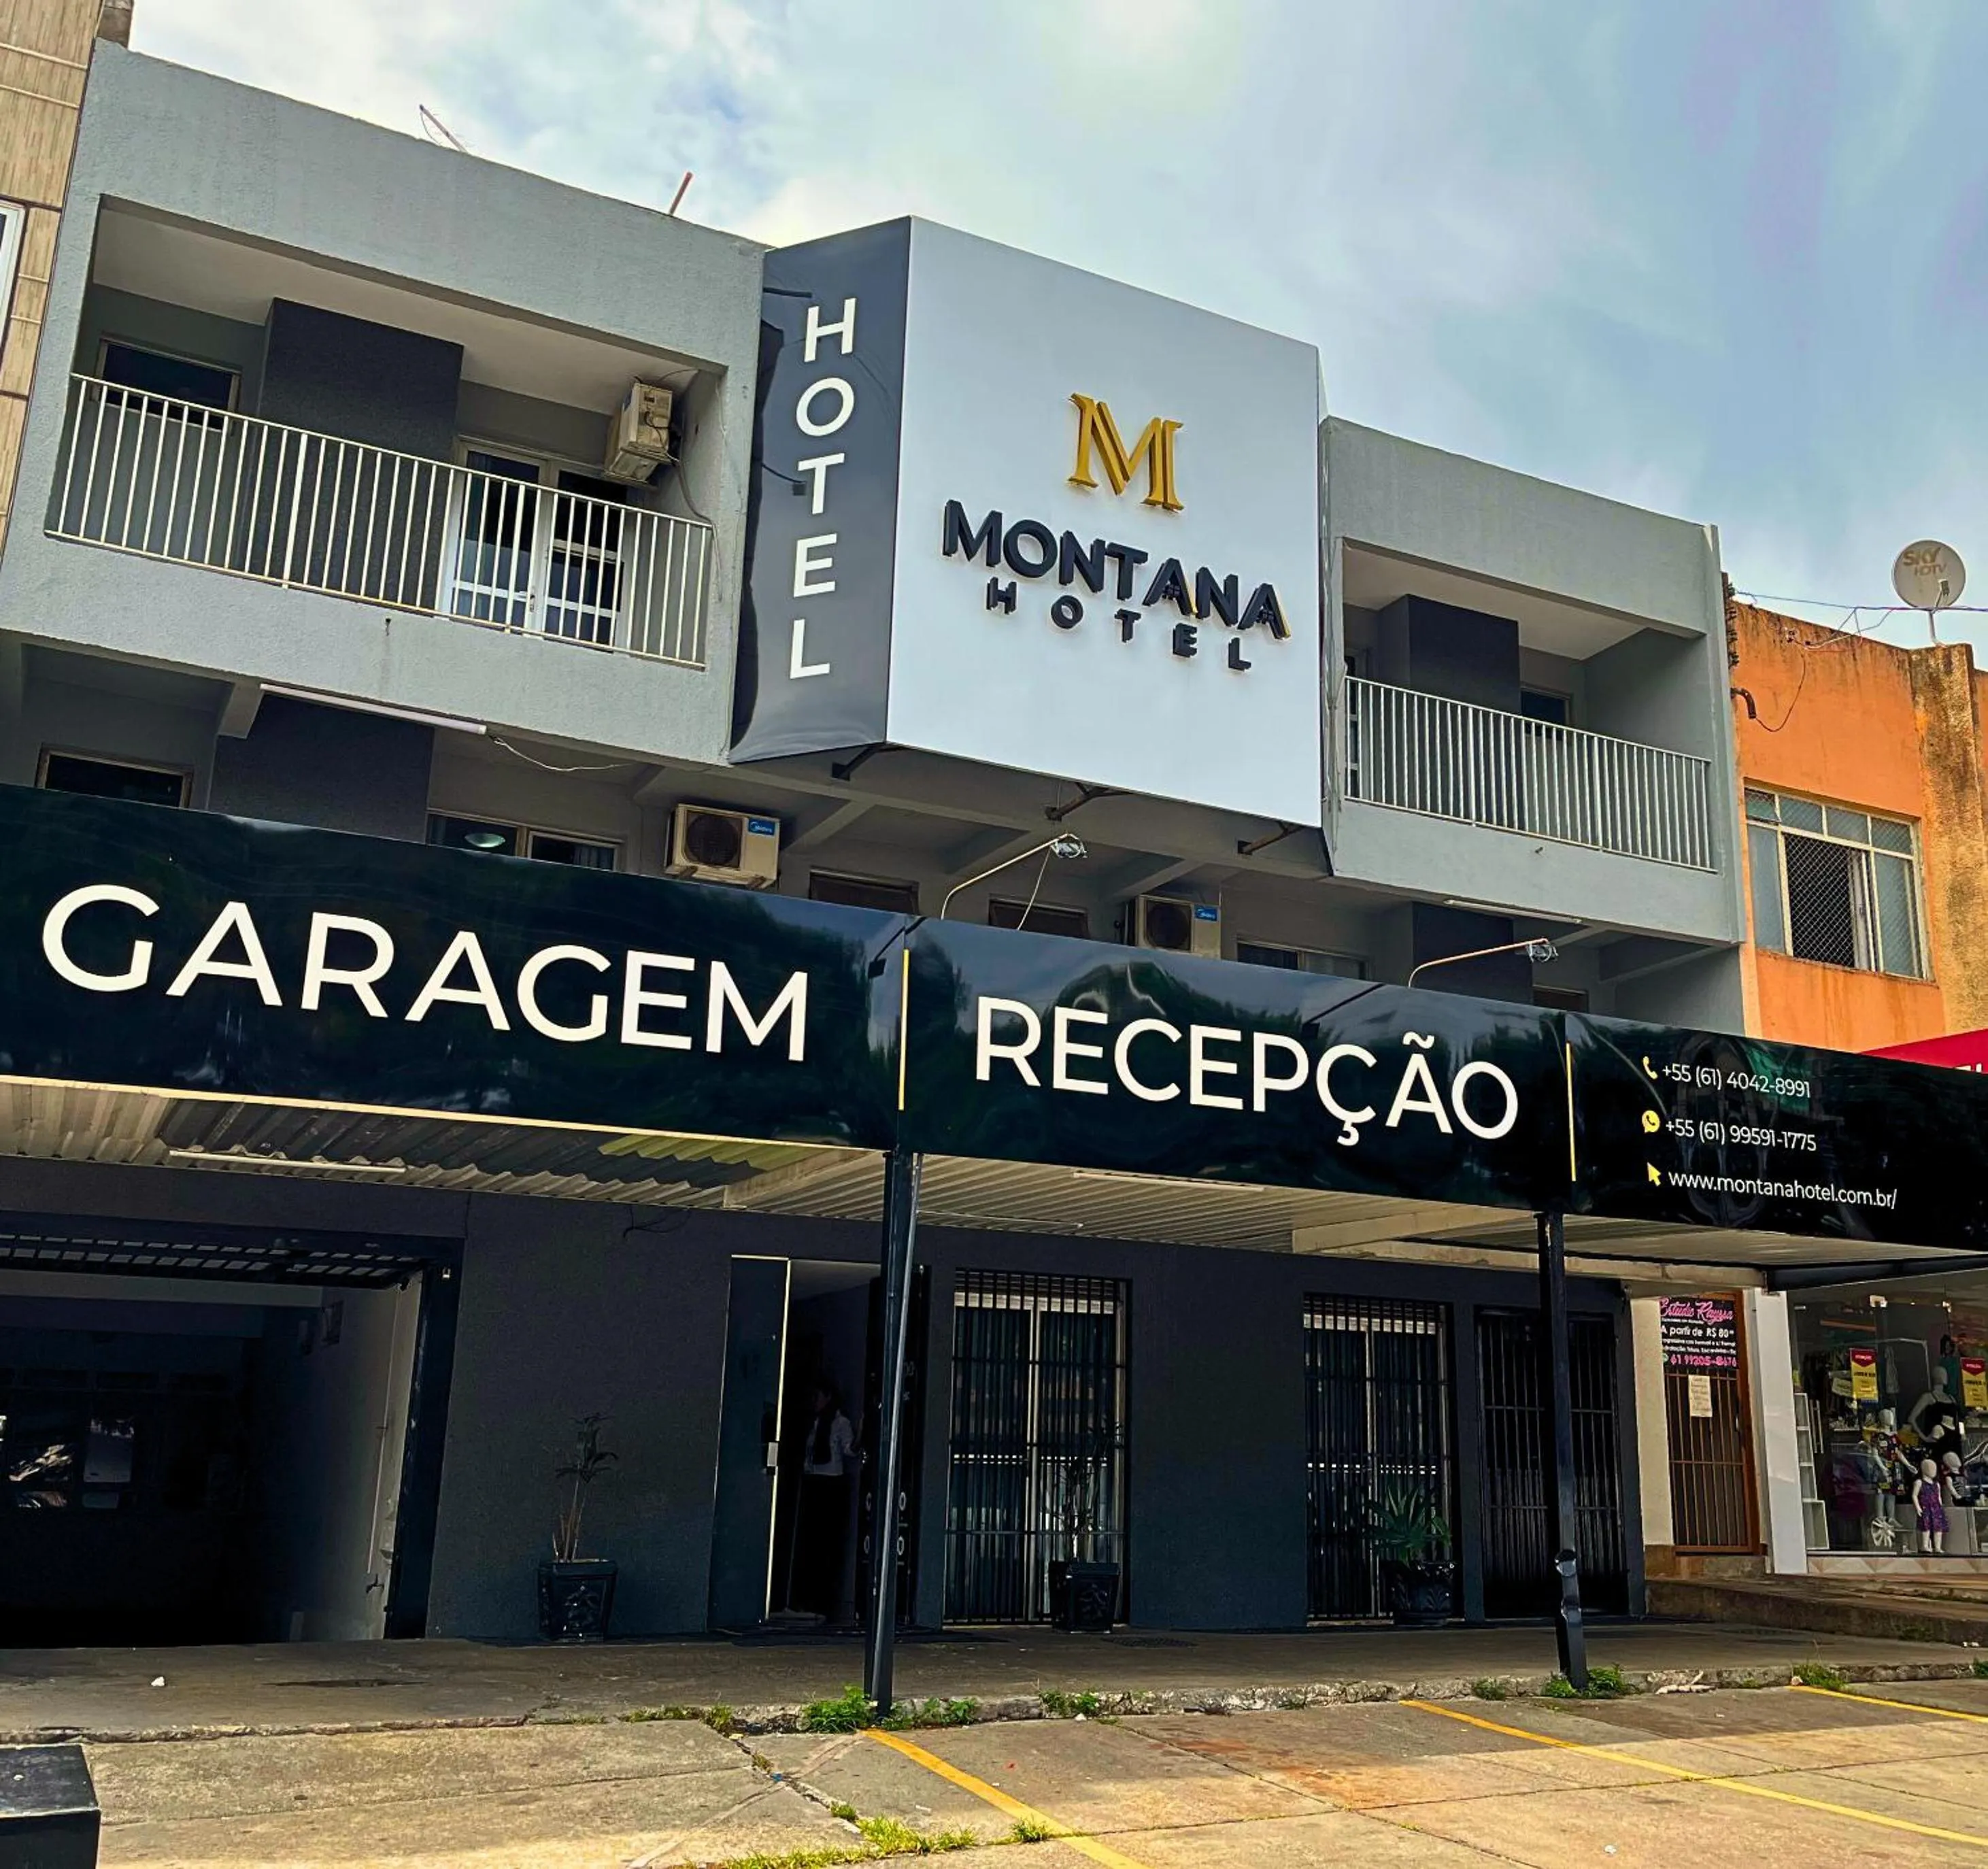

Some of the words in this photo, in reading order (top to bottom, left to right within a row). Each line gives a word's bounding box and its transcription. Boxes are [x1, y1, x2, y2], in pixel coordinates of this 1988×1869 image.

[789, 298, 856, 679] HOTEL
[1067, 392, 1185, 511] M
[943, 500, 1291, 640] MONTANA
[986, 577, 1251, 672] HOTEL
[42, 884, 809, 1062] GARAGEM
[976, 996, 1519, 1147] RECEPÇÃO
[1662, 1063, 1691, 1083] +55
[1696, 1066, 1721, 1090] (61)
[1726, 1072, 1810, 1098] 4042-8991
[1666, 1119, 1694, 1137] +55
[1699, 1121, 1725, 1145] (61)
[1730, 1125, 1817, 1151] 99591-1775
[1668, 1171, 1897, 1209] www.montanahotel.com.br/
[1691, 1328, 1703, 1336] de
[1706, 1328, 1717, 1338] R$
